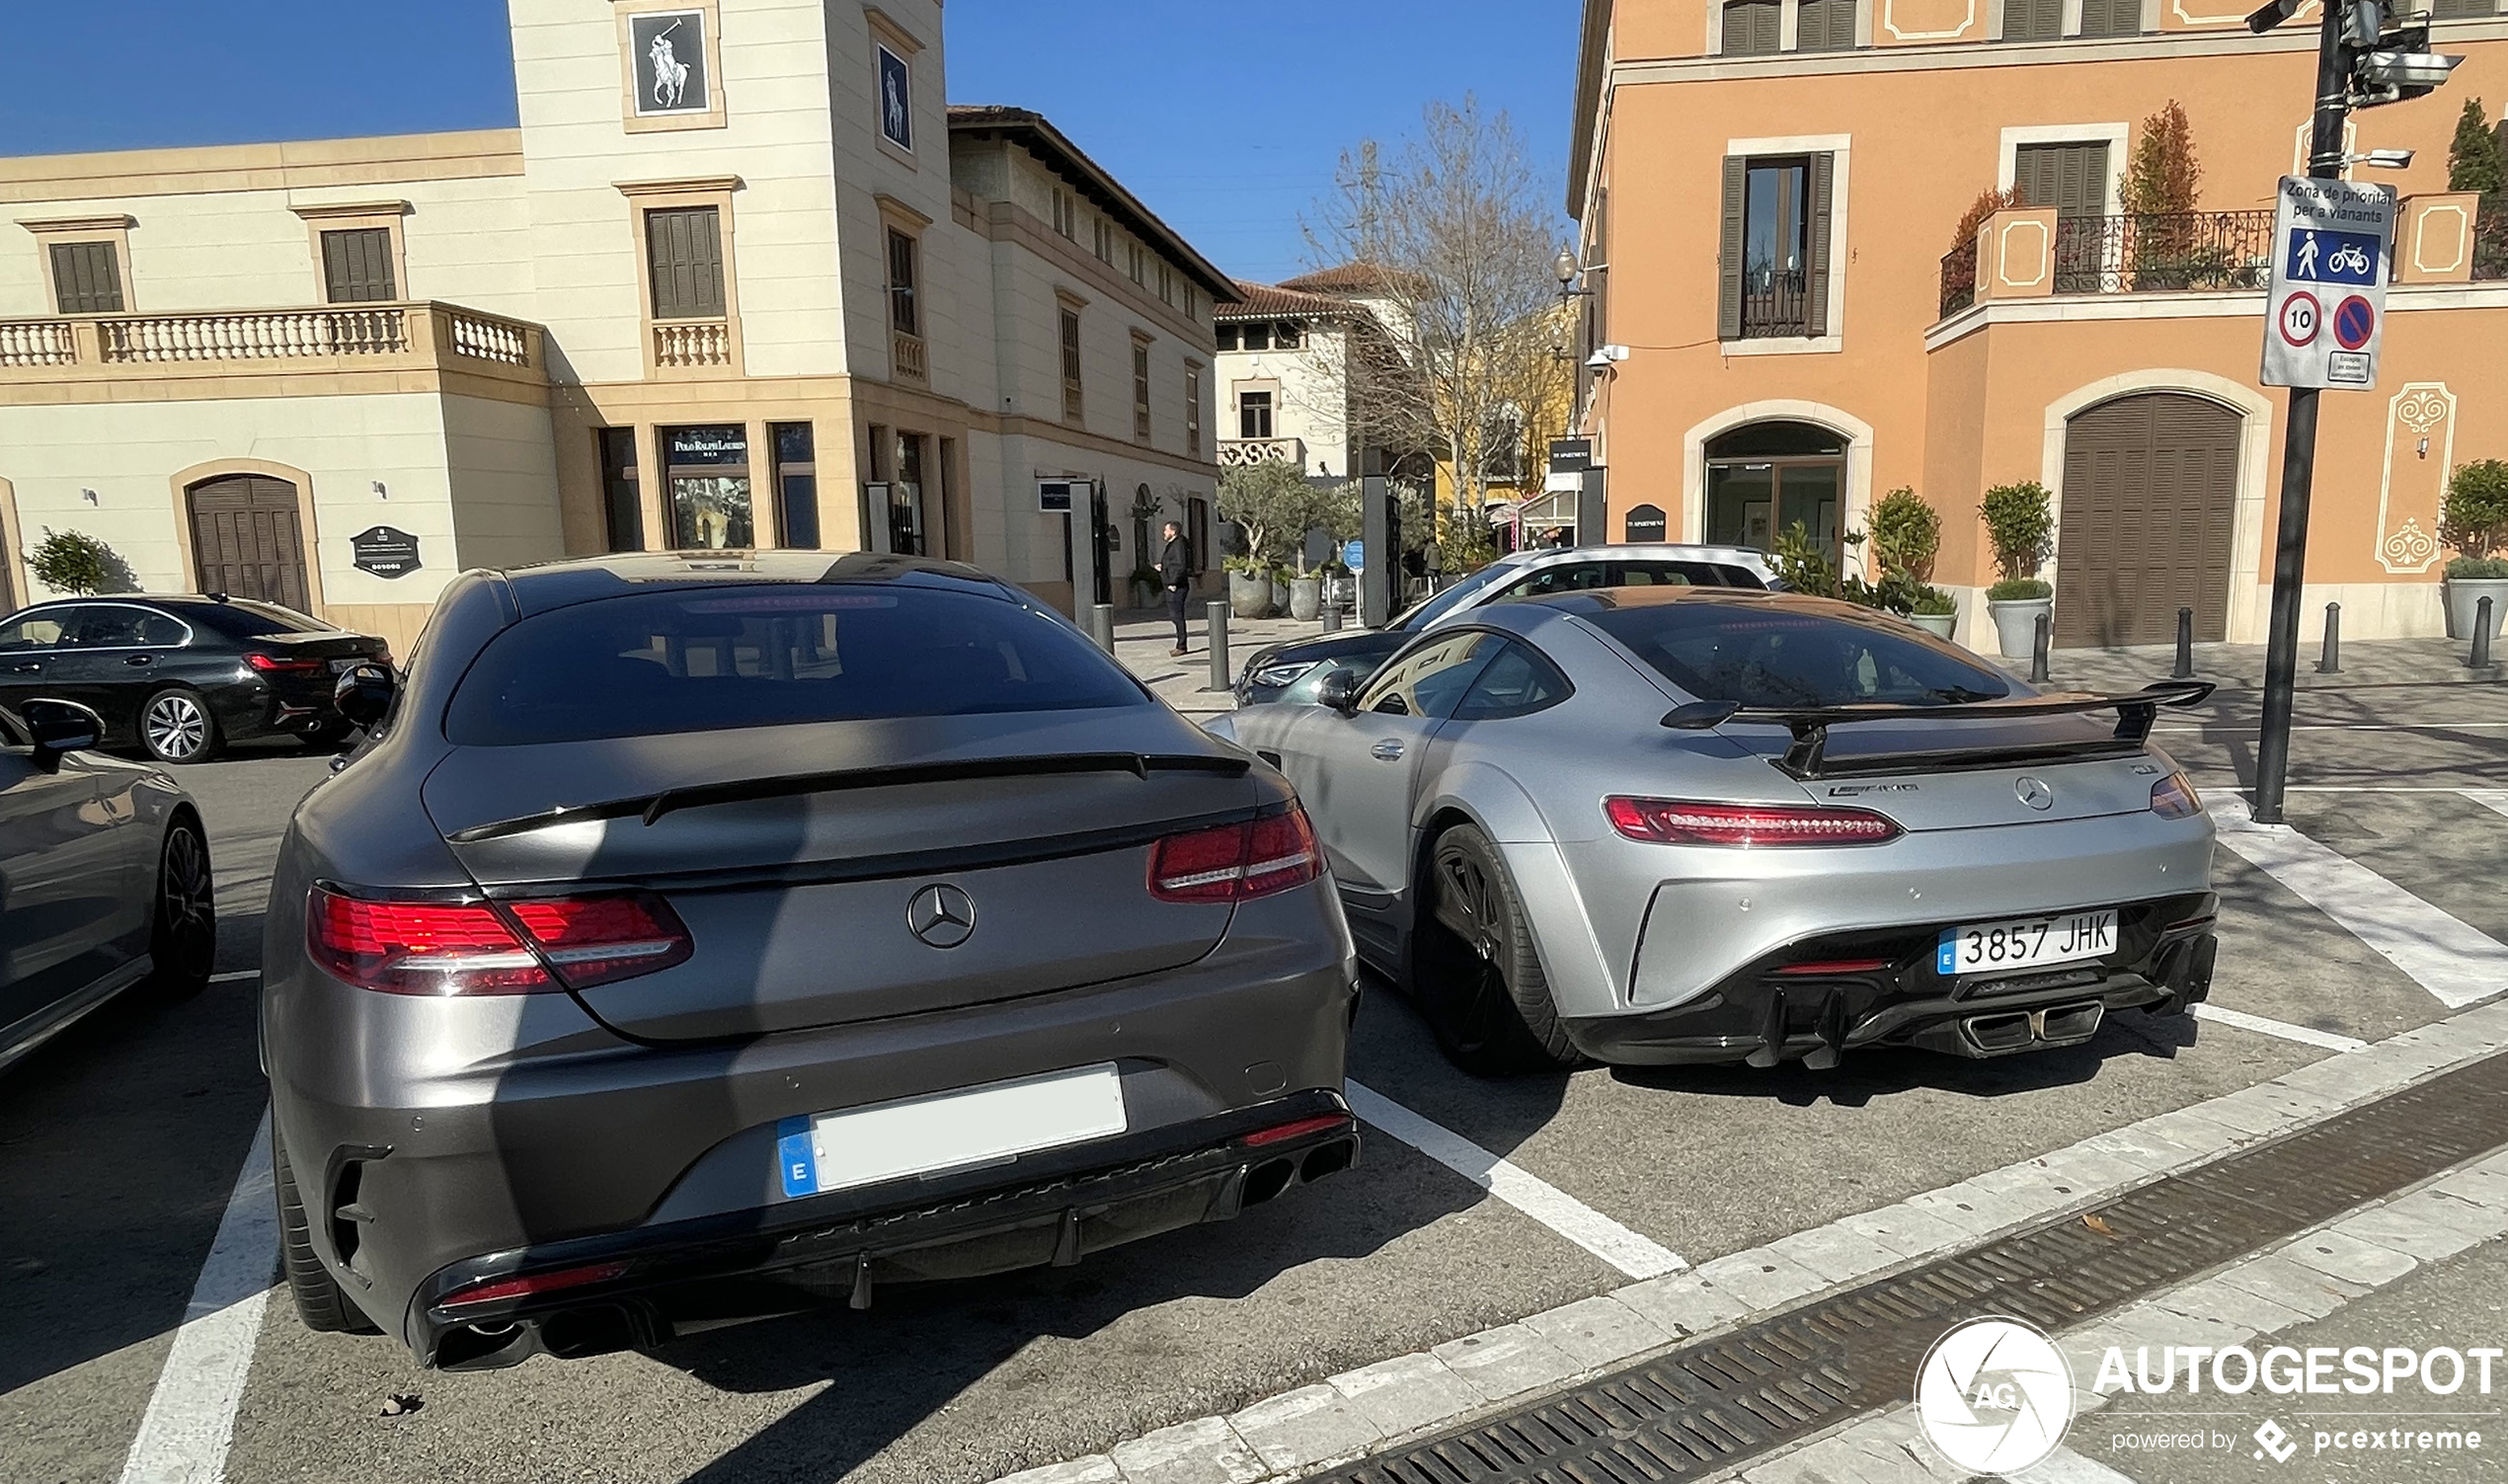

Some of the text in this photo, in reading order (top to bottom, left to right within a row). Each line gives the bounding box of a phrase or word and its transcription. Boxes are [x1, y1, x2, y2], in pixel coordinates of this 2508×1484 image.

[2287, 182, 2391, 205] Zona de prioritat
[2293, 204, 2383, 223] per a vianants
[2292, 310, 2312, 329] 10
[1943, 913, 2111, 965] E 3857 JHK
[793, 1163, 807, 1180] E
